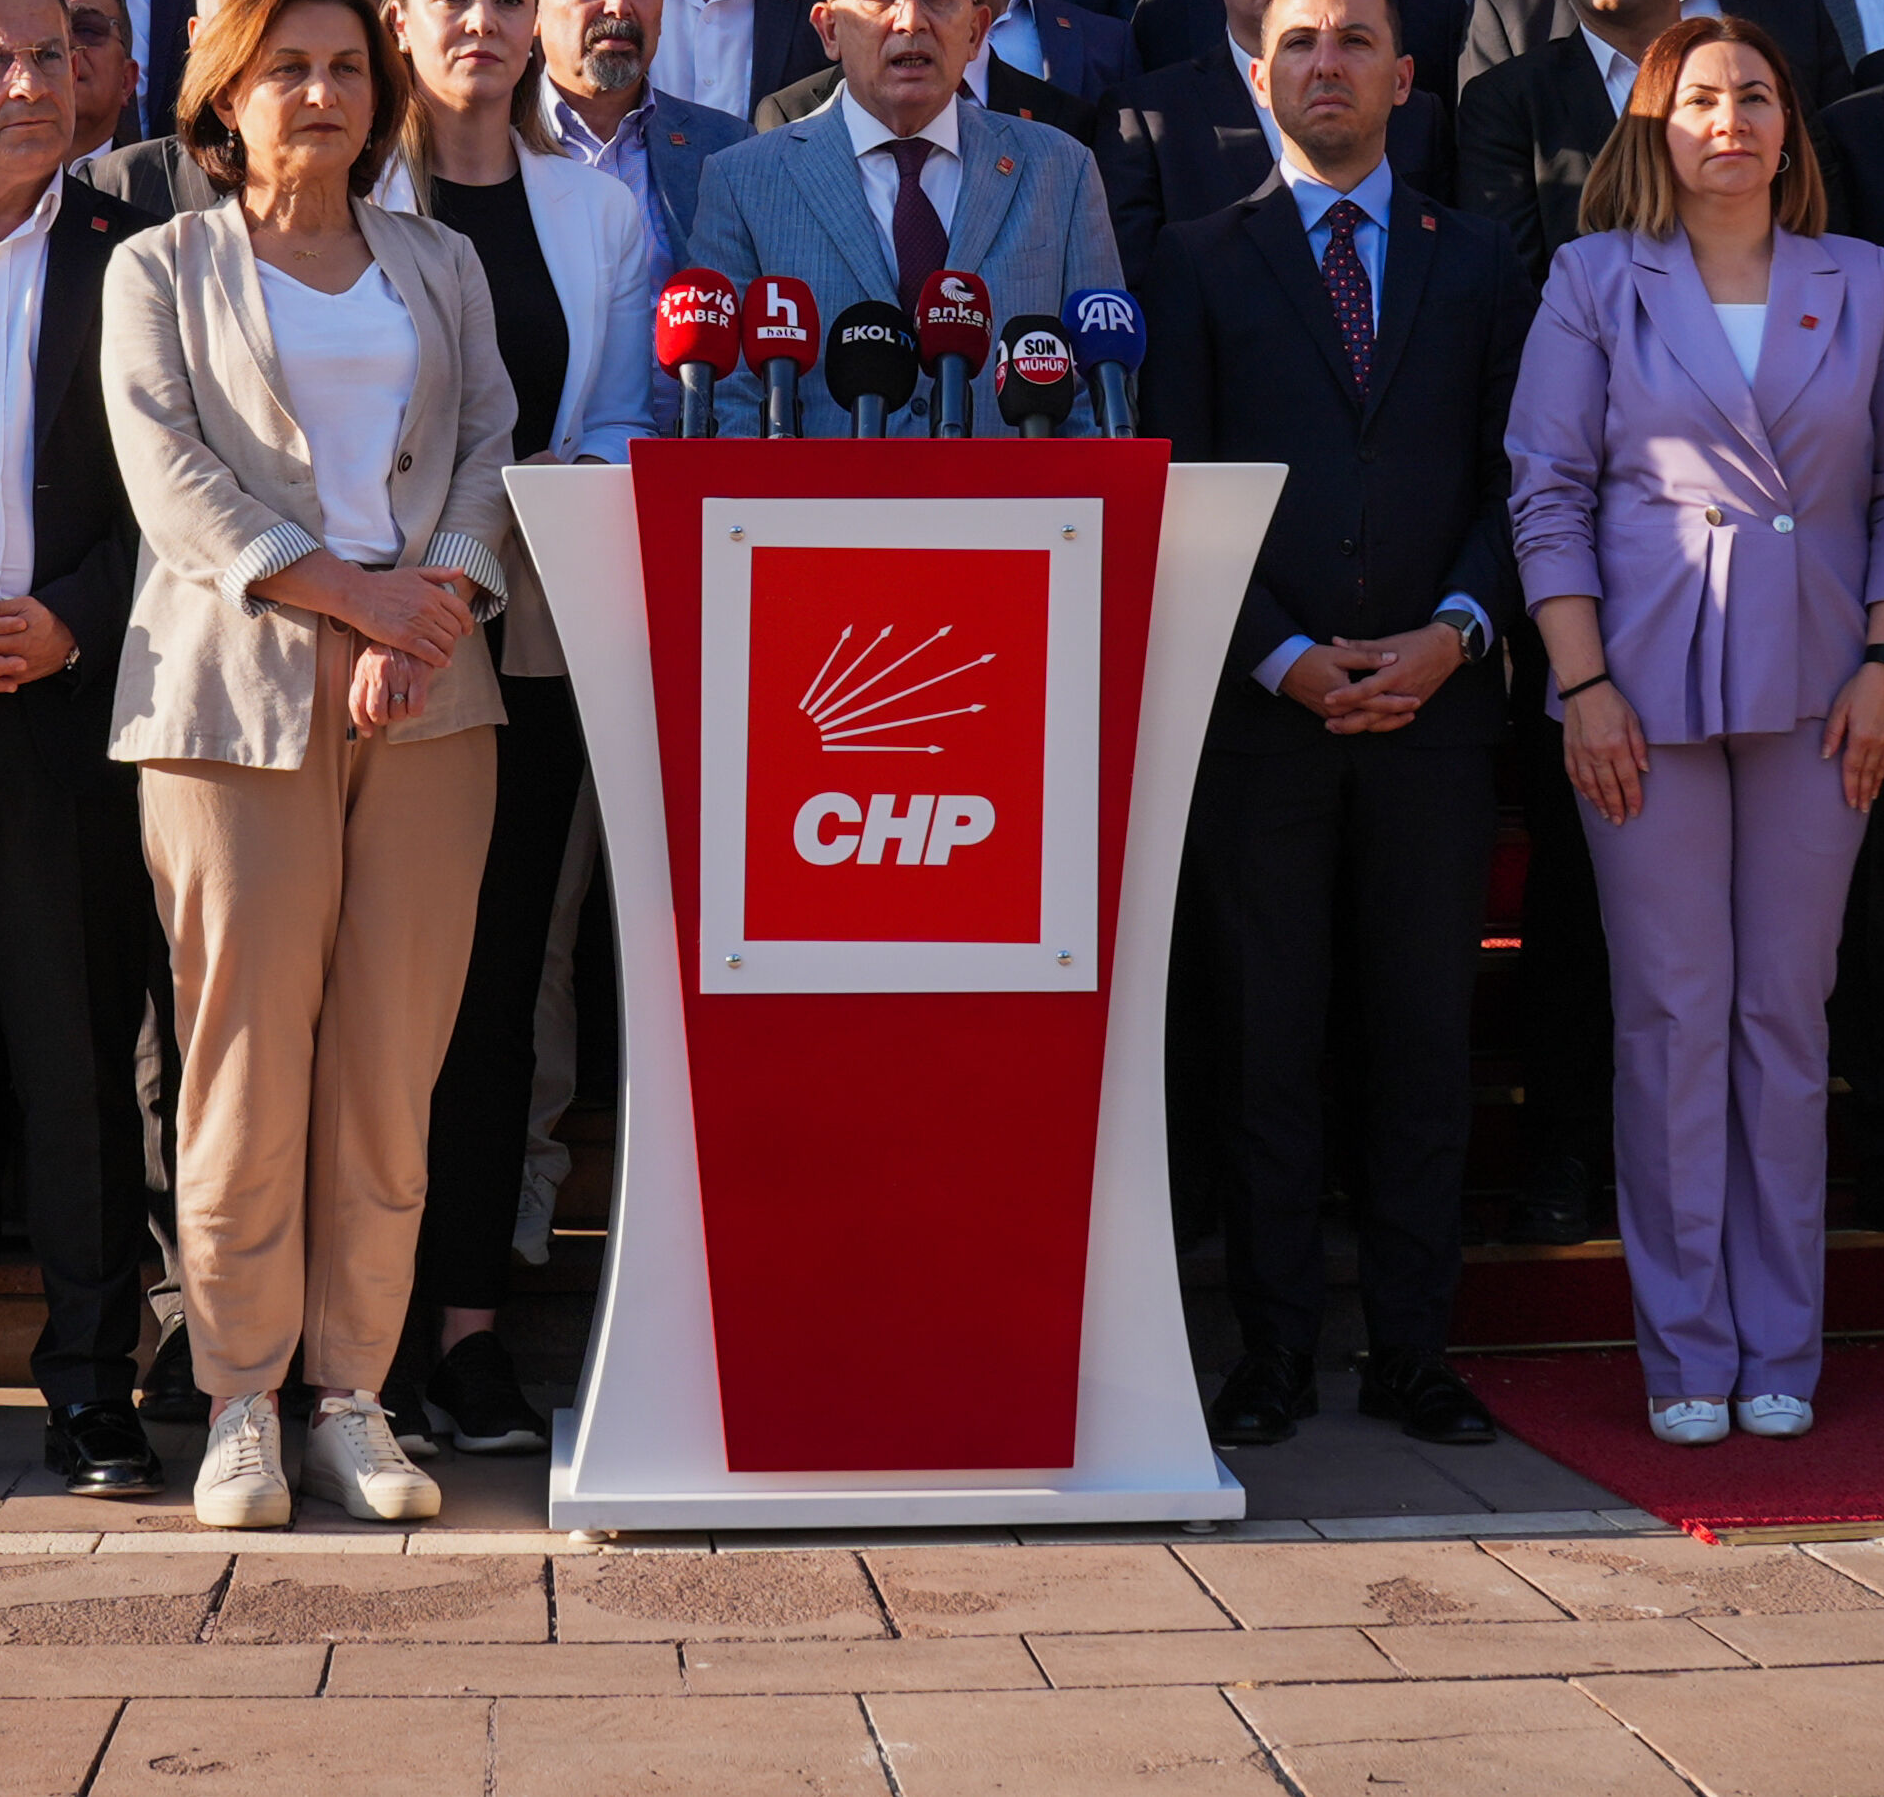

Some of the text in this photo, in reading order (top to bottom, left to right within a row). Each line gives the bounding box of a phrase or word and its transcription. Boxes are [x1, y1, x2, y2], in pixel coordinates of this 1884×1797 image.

[668, 309, 729, 328] HABER
[928, 302, 984, 324] anka
[1080, 302, 1136, 334] AA
[767, 327, 798, 338] halk
[841, 324, 896, 345] EKOL
[1024, 338, 1057, 356] SON
[1018, 357, 1065, 372] MÜHÜR
[792, 791, 996, 867] CHP
